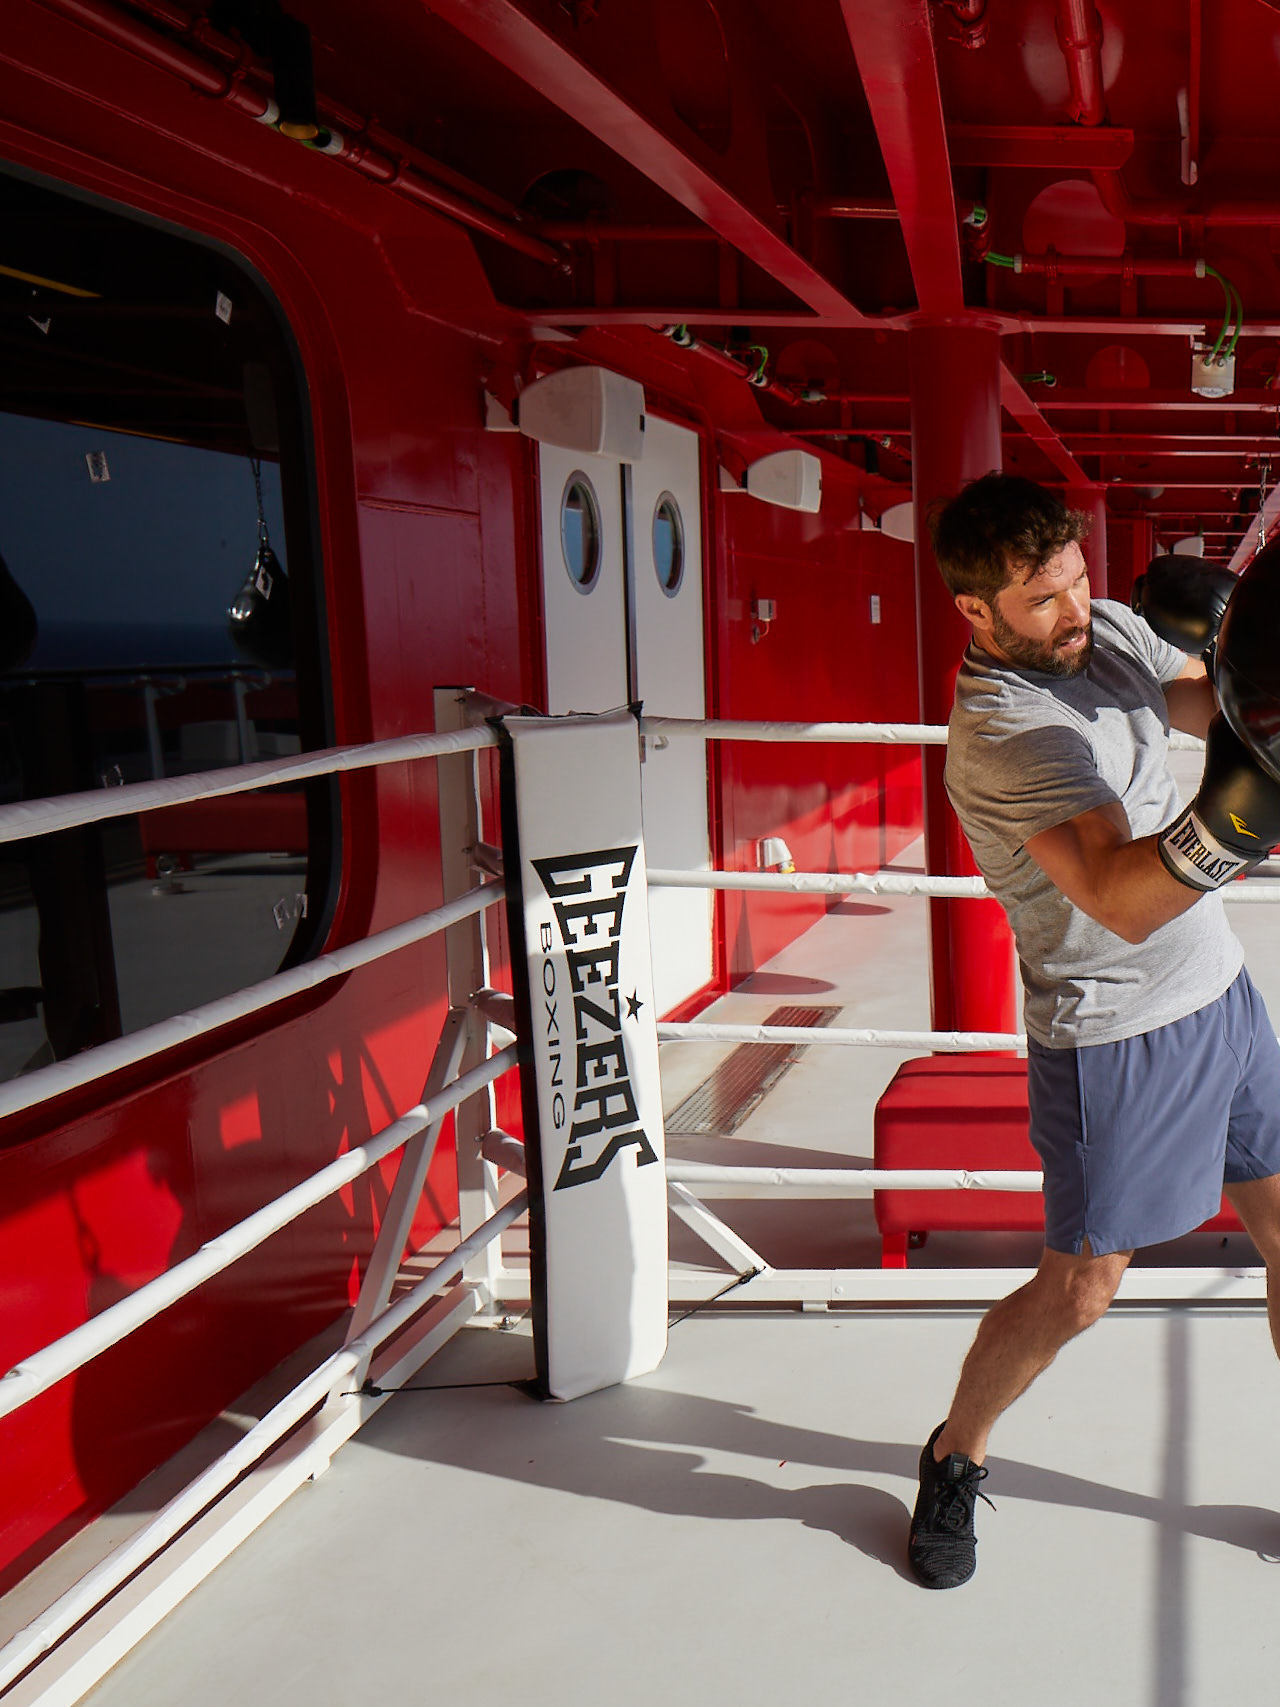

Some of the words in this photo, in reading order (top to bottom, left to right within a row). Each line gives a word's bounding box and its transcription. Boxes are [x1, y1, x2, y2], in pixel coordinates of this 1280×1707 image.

[1169, 817, 1240, 882] EVERLAST
[529, 845, 659, 1192] GEEZERS
[540, 922, 565, 1130] BOXING
